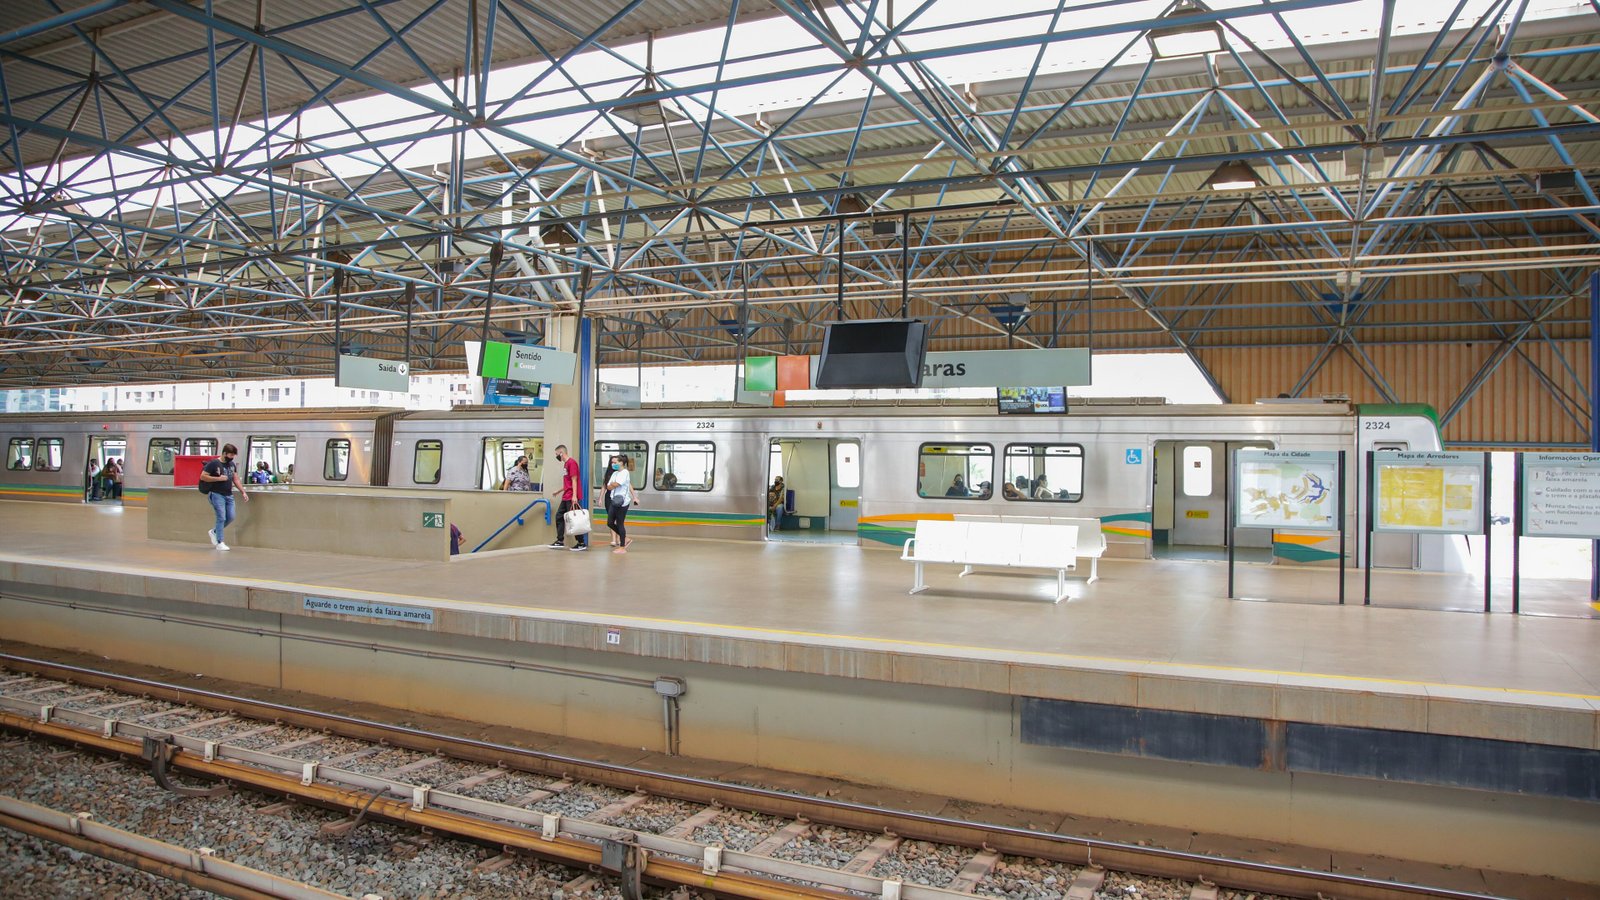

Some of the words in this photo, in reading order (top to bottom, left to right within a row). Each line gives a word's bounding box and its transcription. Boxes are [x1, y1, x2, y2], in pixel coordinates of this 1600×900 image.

[516, 350, 541, 361] Sentido
[378, 363, 397, 373] Saída
[696, 421, 715, 429] 2324
[1365, 421, 1391, 430] 2324
[305, 599, 332, 609] Aguarde
[357, 605, 373, 613] atrás
[385, 608, 401, 616] faixa
[403, 611, 431, 620] amarela
